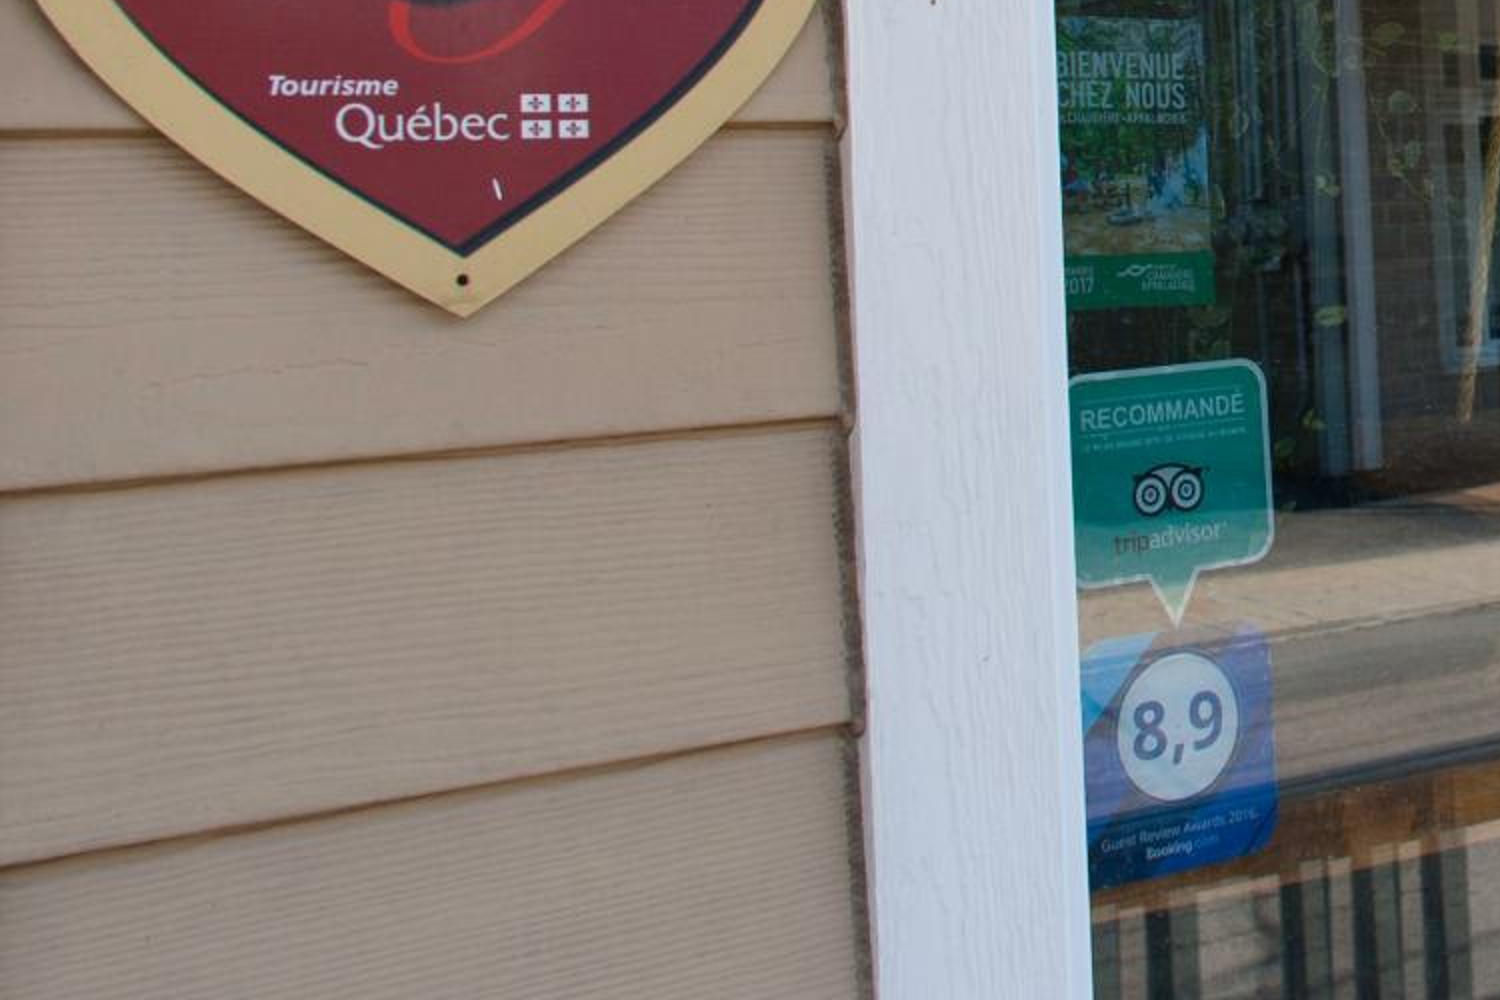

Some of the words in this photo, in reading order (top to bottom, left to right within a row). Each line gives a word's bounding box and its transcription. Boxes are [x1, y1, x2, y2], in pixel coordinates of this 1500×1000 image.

[1057, 51, 1185, 80] BIENVENUE
[268, 75, 399, 96] Tourisme
[1058, 81, 1114, 109] CHEZ
[1126, 82, 1185, 110] NOUS
[335, 101, 510, 149] Québec
[1079, 388, 1246, 433] RECOMMANDÉ
[1113, 522, 1222, 555] tripadvisor
[1132, 689, 1223, 765] 8,9
[1100, 833, 1137, 854] Guest
[1139, 823, 1181, 843] Review
